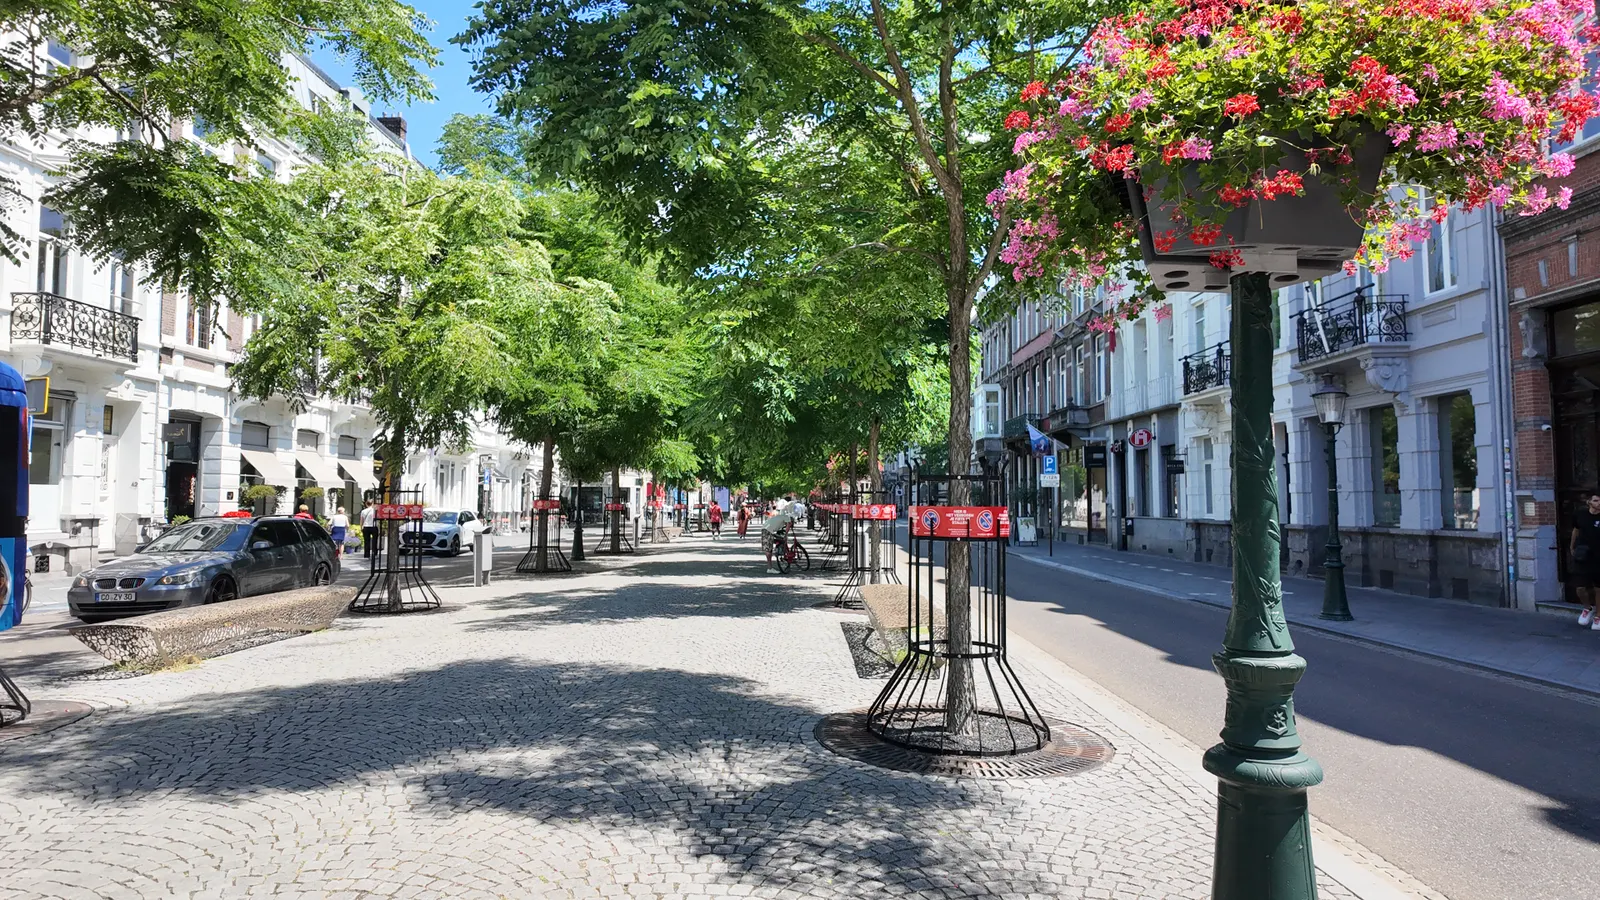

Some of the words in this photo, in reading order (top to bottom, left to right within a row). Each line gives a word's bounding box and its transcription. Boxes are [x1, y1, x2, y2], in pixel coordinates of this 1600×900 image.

[1046, 457, 1054, 467] P
[101, 593, 110, 601] CO
[123, 593, 133, 601] 30
